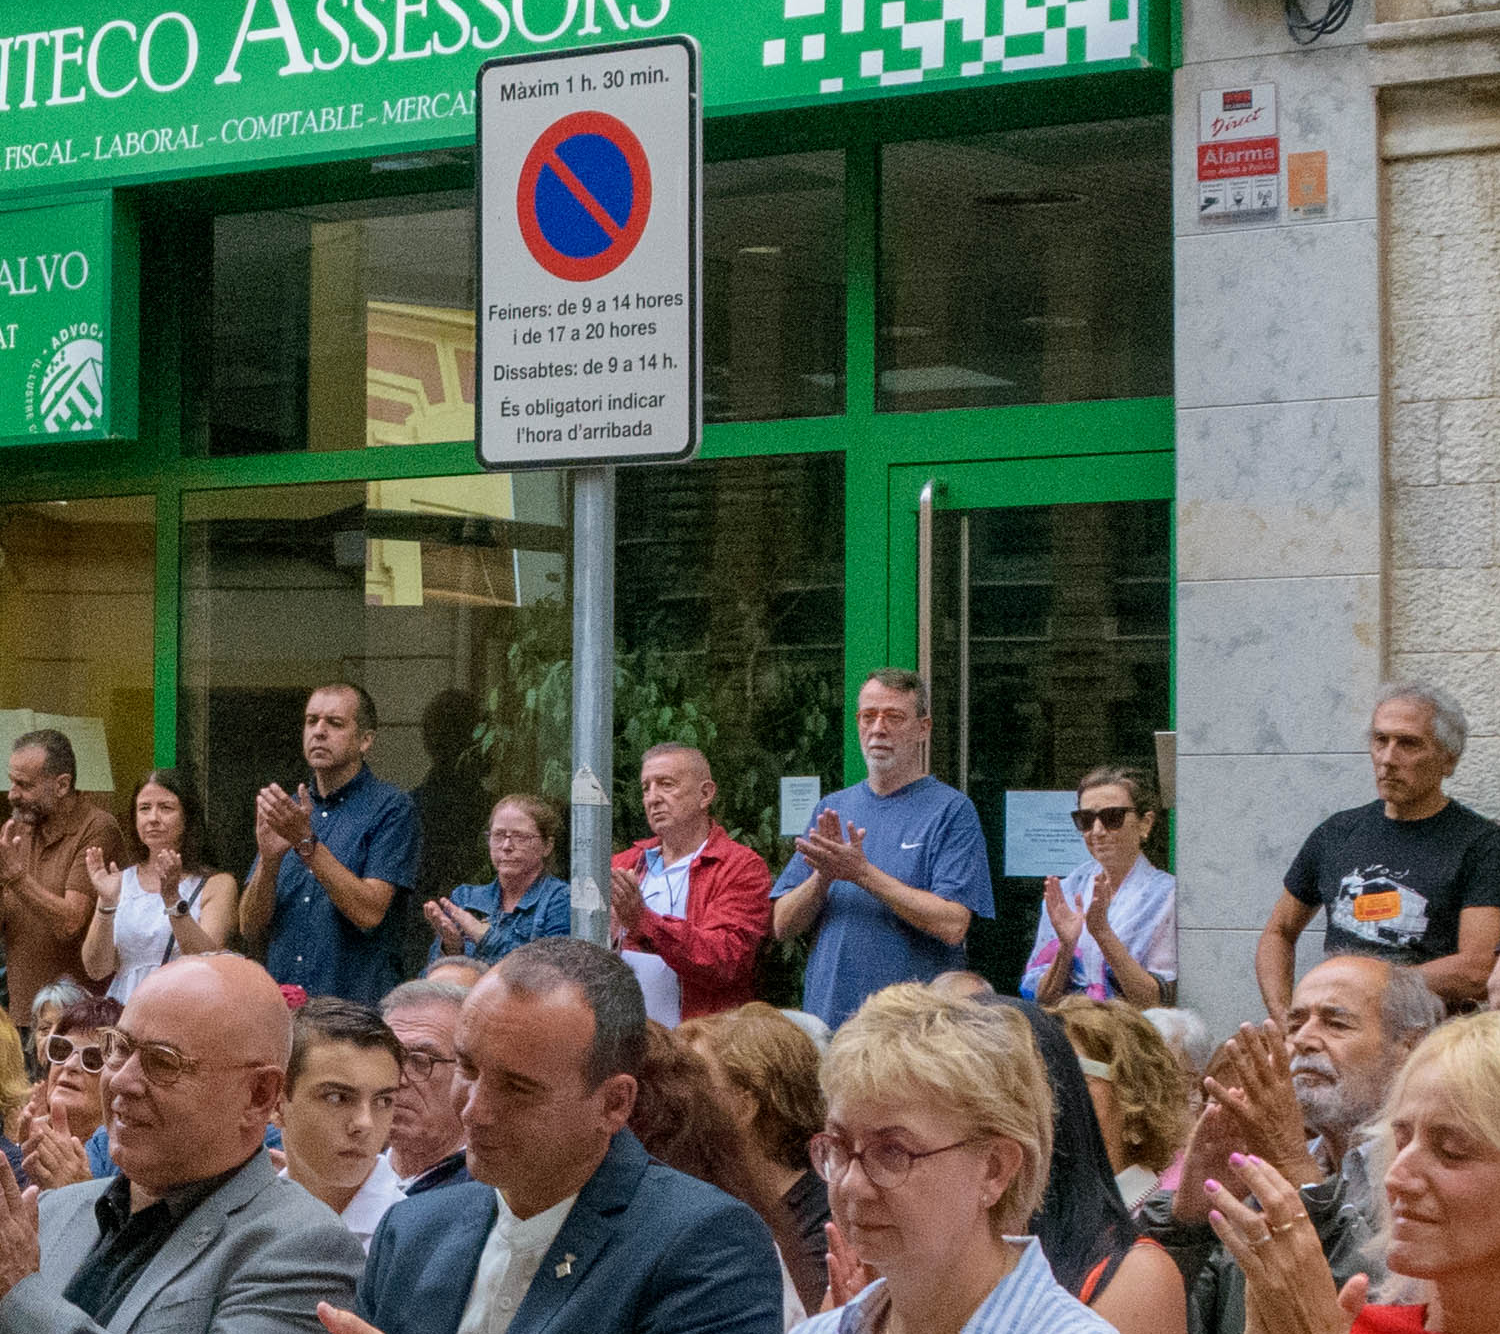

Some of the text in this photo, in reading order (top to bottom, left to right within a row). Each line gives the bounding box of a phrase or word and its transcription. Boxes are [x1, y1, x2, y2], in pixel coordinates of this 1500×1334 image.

[500, 66, 670, 102] Màxim 1 h. 30 min.
[5, 138, 78, 172] FISCAL
[94, 123, 205, 161] LABORAL
[220, 101, 365, 142] COMPTABLE
[1210, 107, 1265, 138] Direct
[1203, 146, 1275, 166] Alarma
[488, 290, 684, 321] Feiners: de 9 a 14 hores
[512, 318, 657, 346] i de 17 a 20 hores
[493, 353, 678, 383] Dissabtes: de 9 a 14 h.
[500, 391, 666, 421] És obligatori indicar
